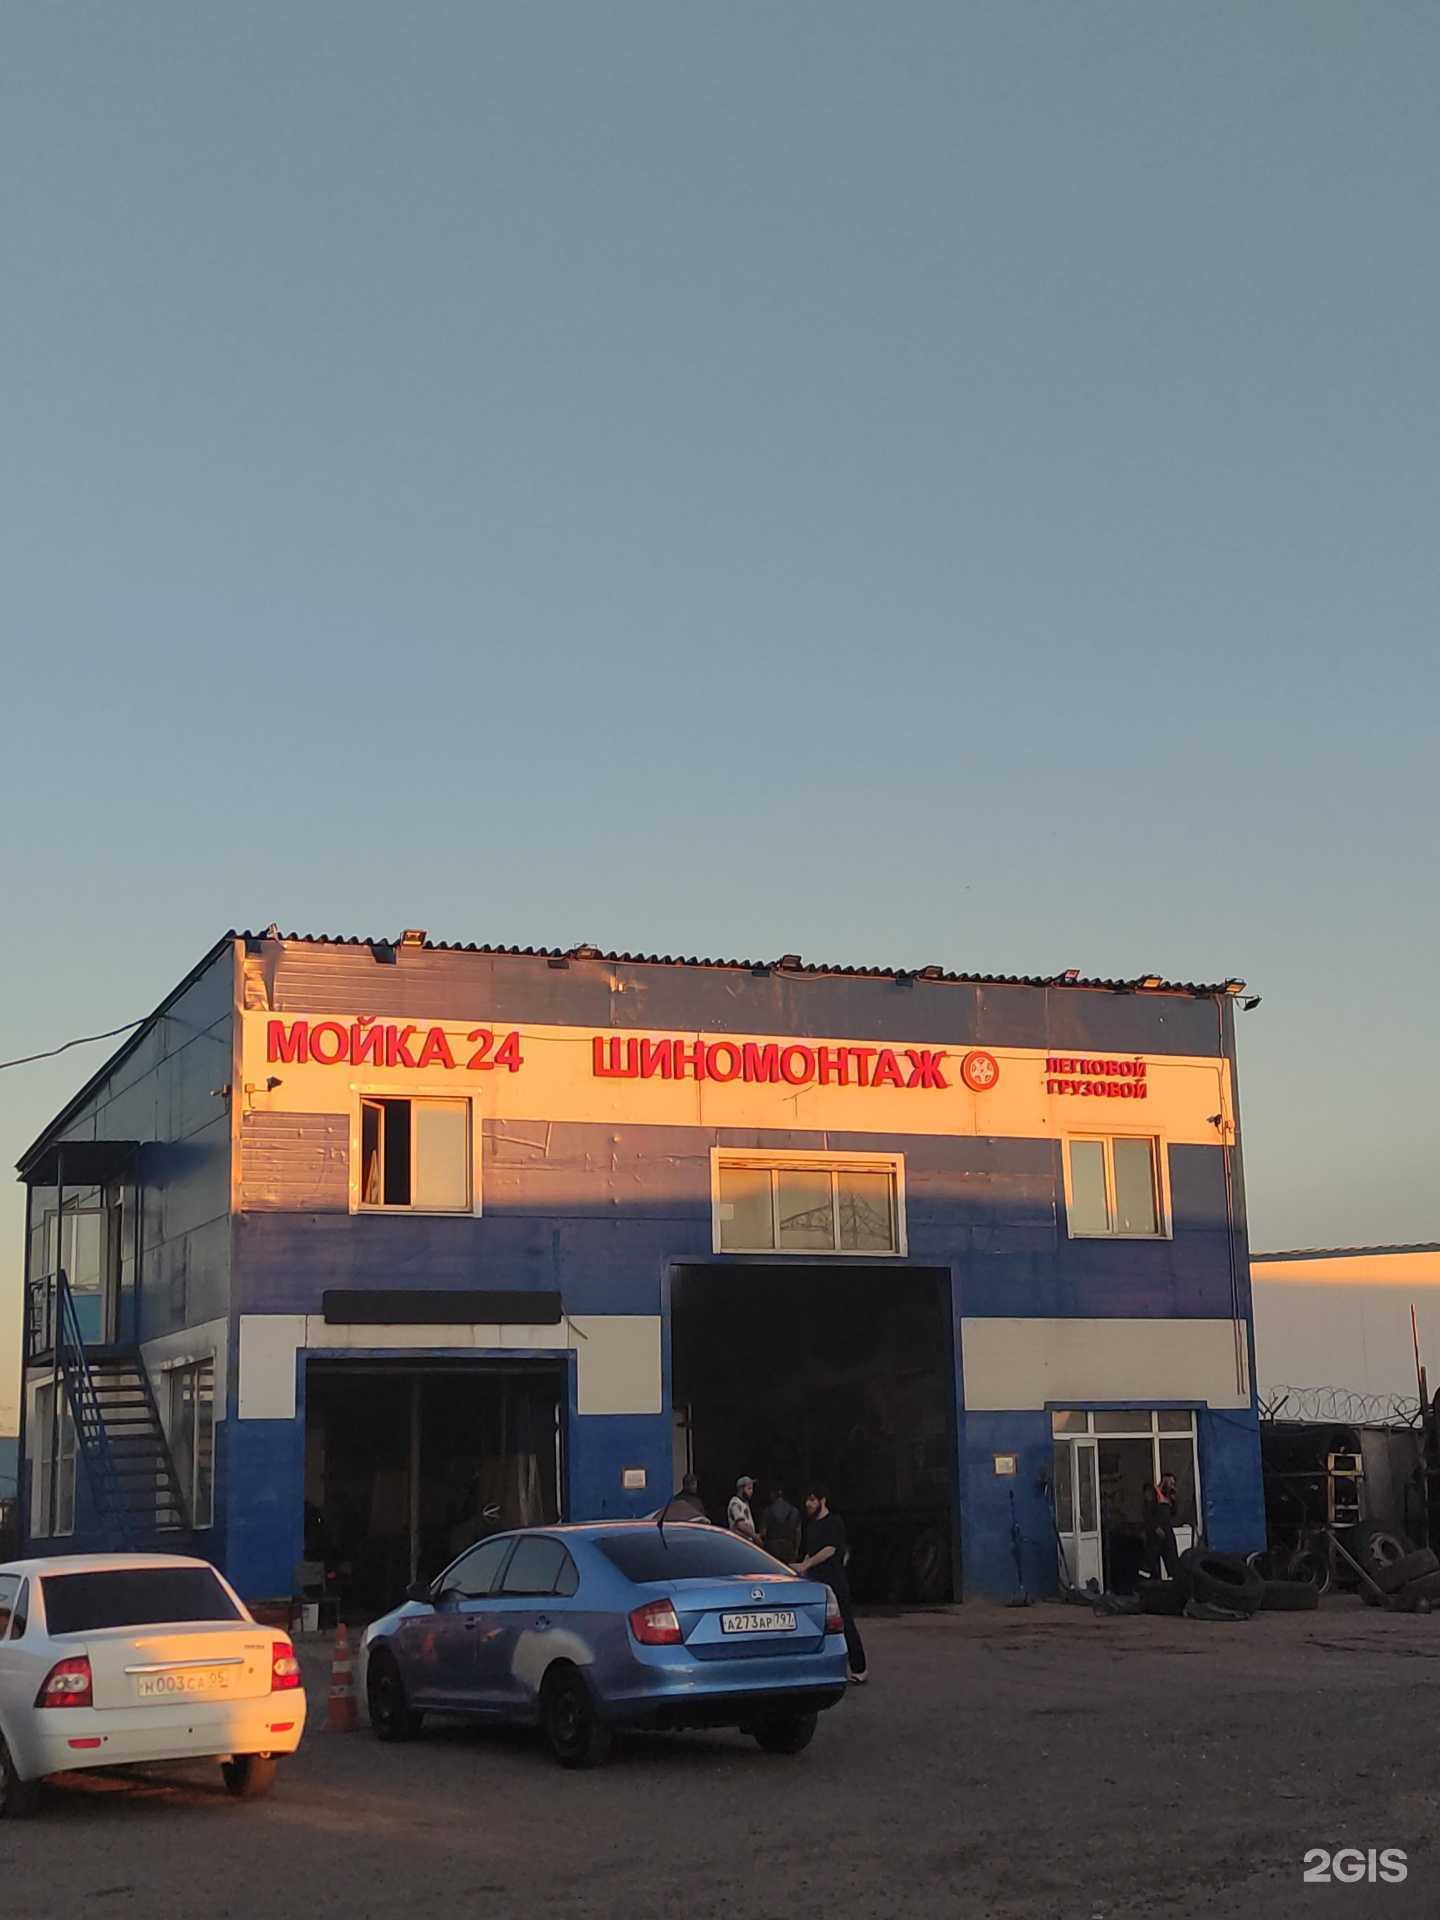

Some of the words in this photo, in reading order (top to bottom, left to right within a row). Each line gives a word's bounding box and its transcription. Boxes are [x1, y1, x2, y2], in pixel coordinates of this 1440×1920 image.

[267, 1016, 456, 1069] МОЙКА
[467, 1029, 524, 1072] 24
[593, 1037, 950, 1088] ШИНОМОНТАЖ
[1046, 1057, 1146, 1077] ЛЕГКОВОЙ
[1047, 1079, 1147, 1098] ГРУЗОВОЙ
